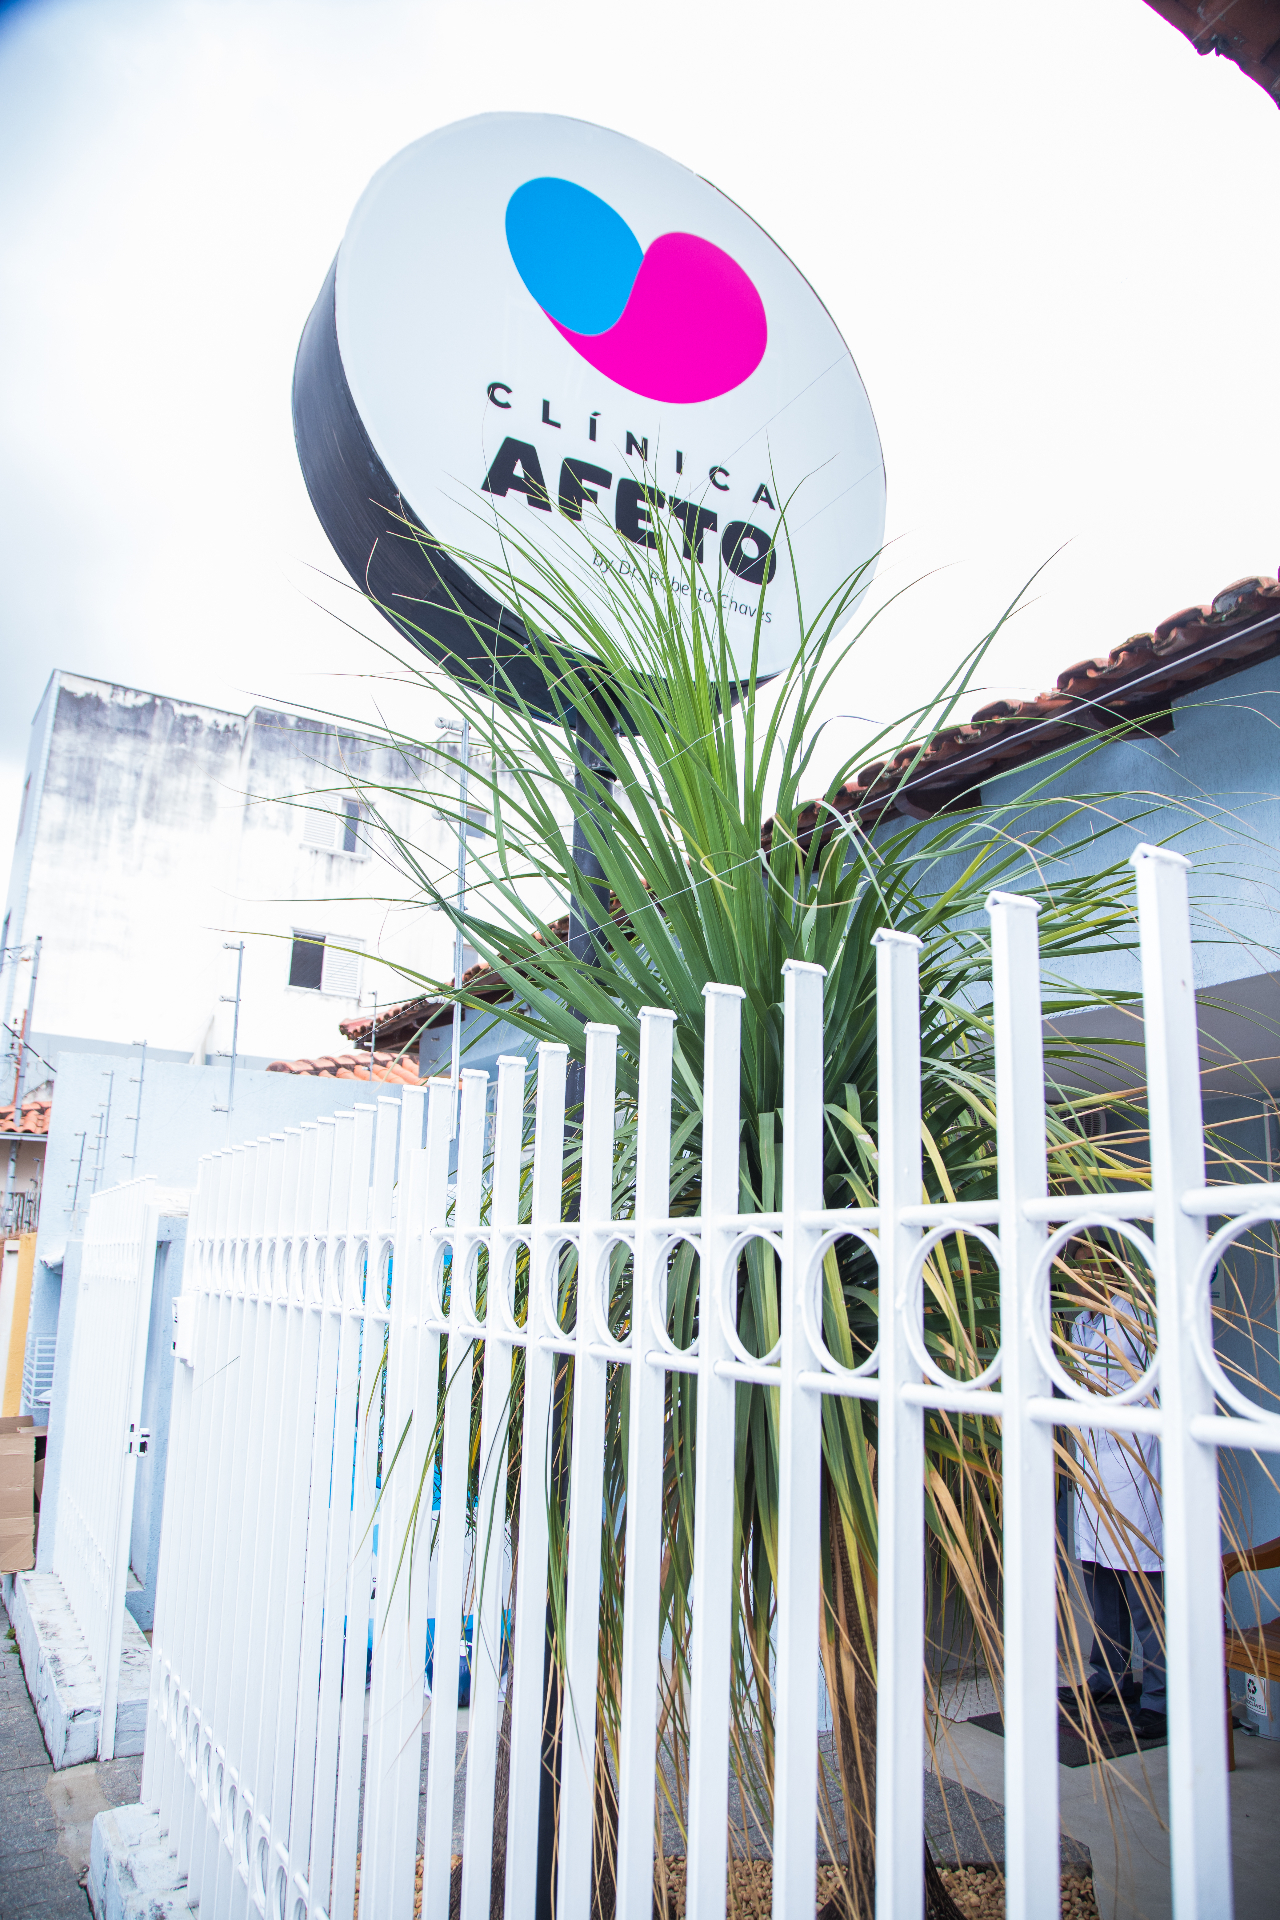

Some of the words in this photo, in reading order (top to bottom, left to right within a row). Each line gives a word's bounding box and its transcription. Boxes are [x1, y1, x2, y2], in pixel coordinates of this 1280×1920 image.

[487, 382, 776, 510] CLÍNICA
[481, 436, 776, 585] AFETO
[650, 571, 712, 603] Rbeto
